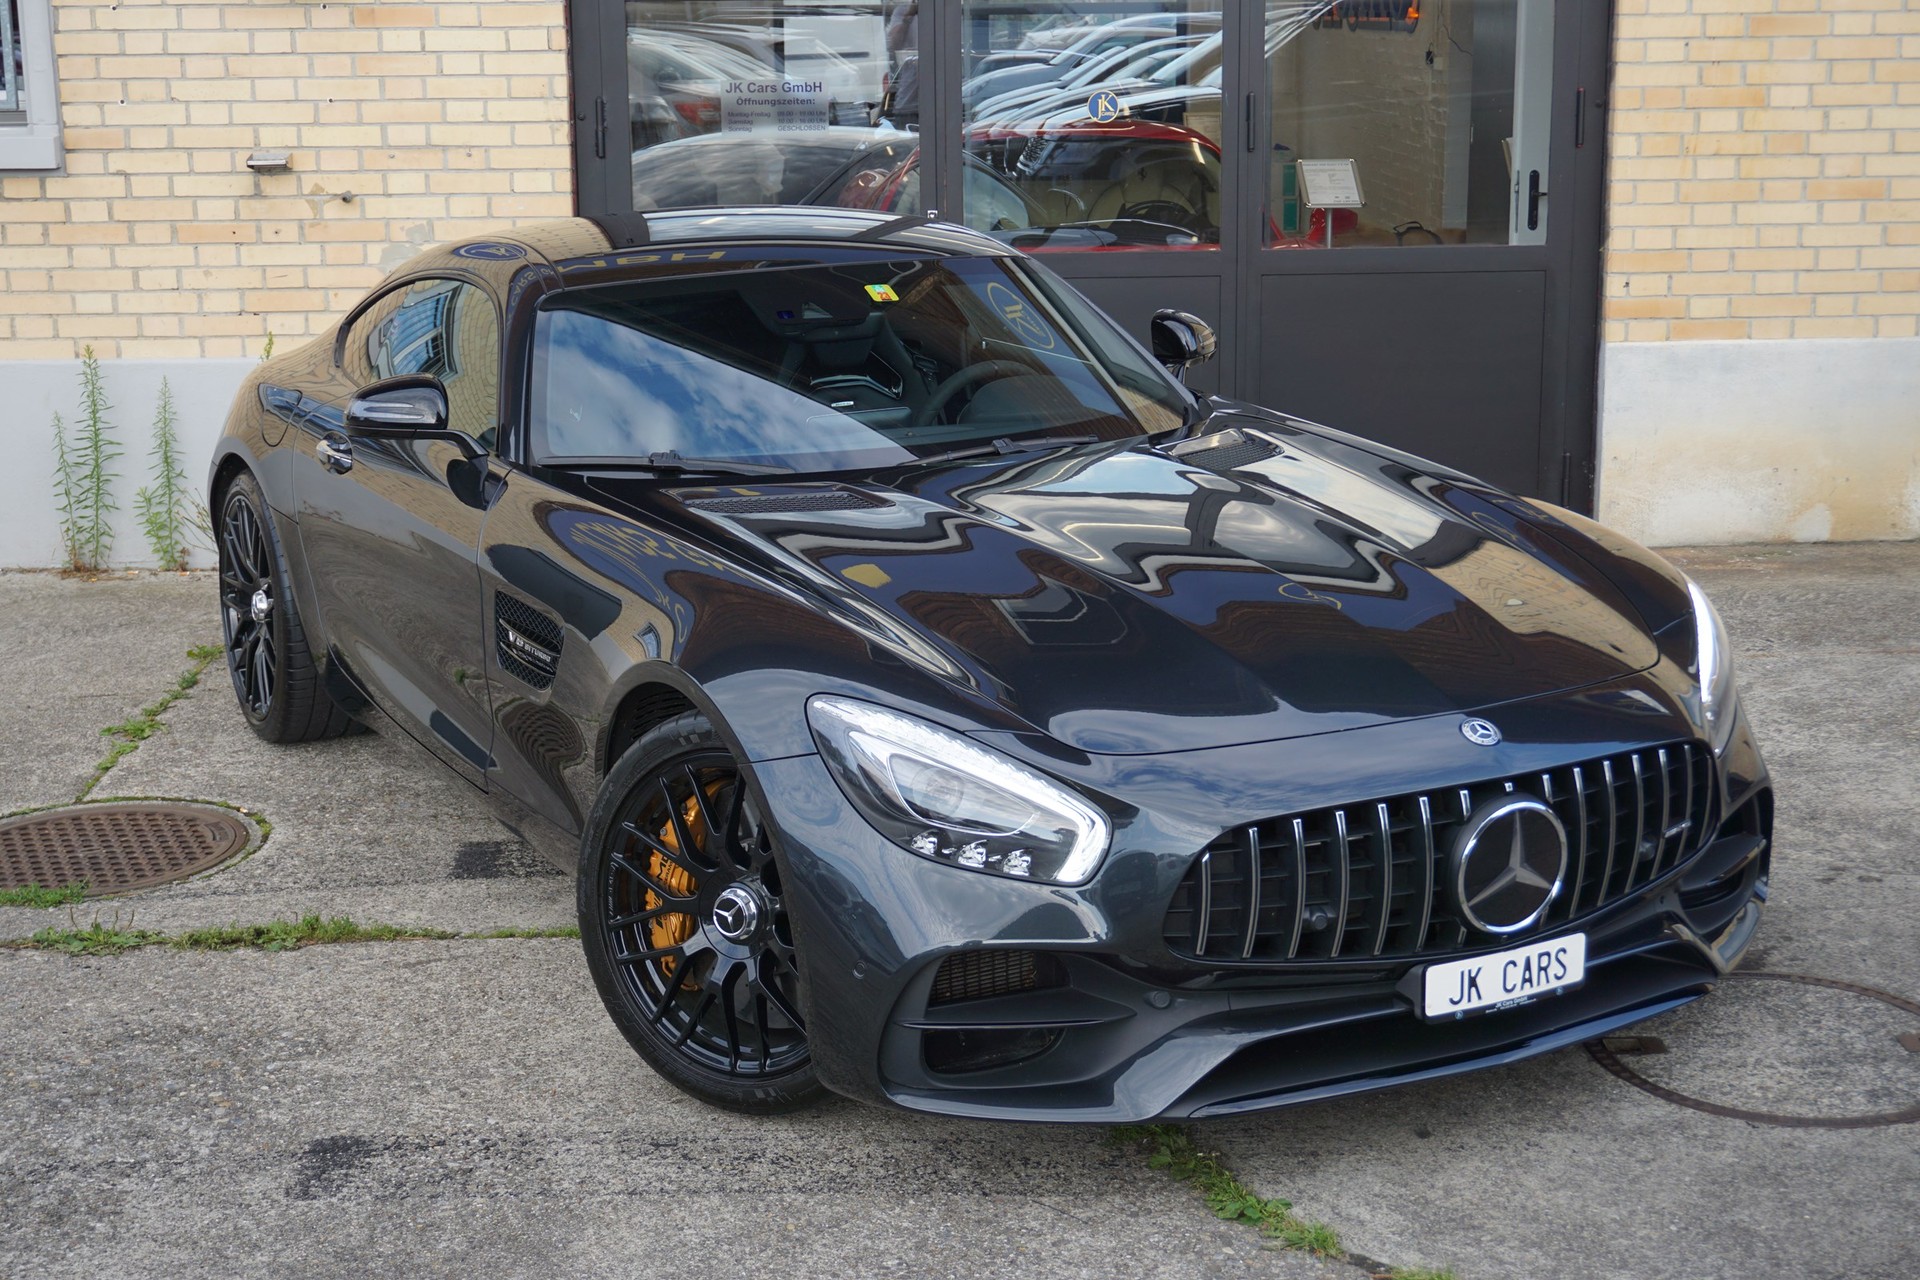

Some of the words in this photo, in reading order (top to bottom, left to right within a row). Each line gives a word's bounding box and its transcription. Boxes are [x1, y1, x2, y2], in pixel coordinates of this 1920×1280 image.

[725, 82, 743, 93] JK
[747, 82, 777, 93] Cars
[781, 81, 822, 93] GmbH
[736, 96, 815, 107] Öffnungszeiten:
[508, 630, 524, 648] V8
[524, 643, 551, 663] BITURBO
[1448, 966, 1482, 1006] JK
[1502, 947, 1567, 994] CARS
